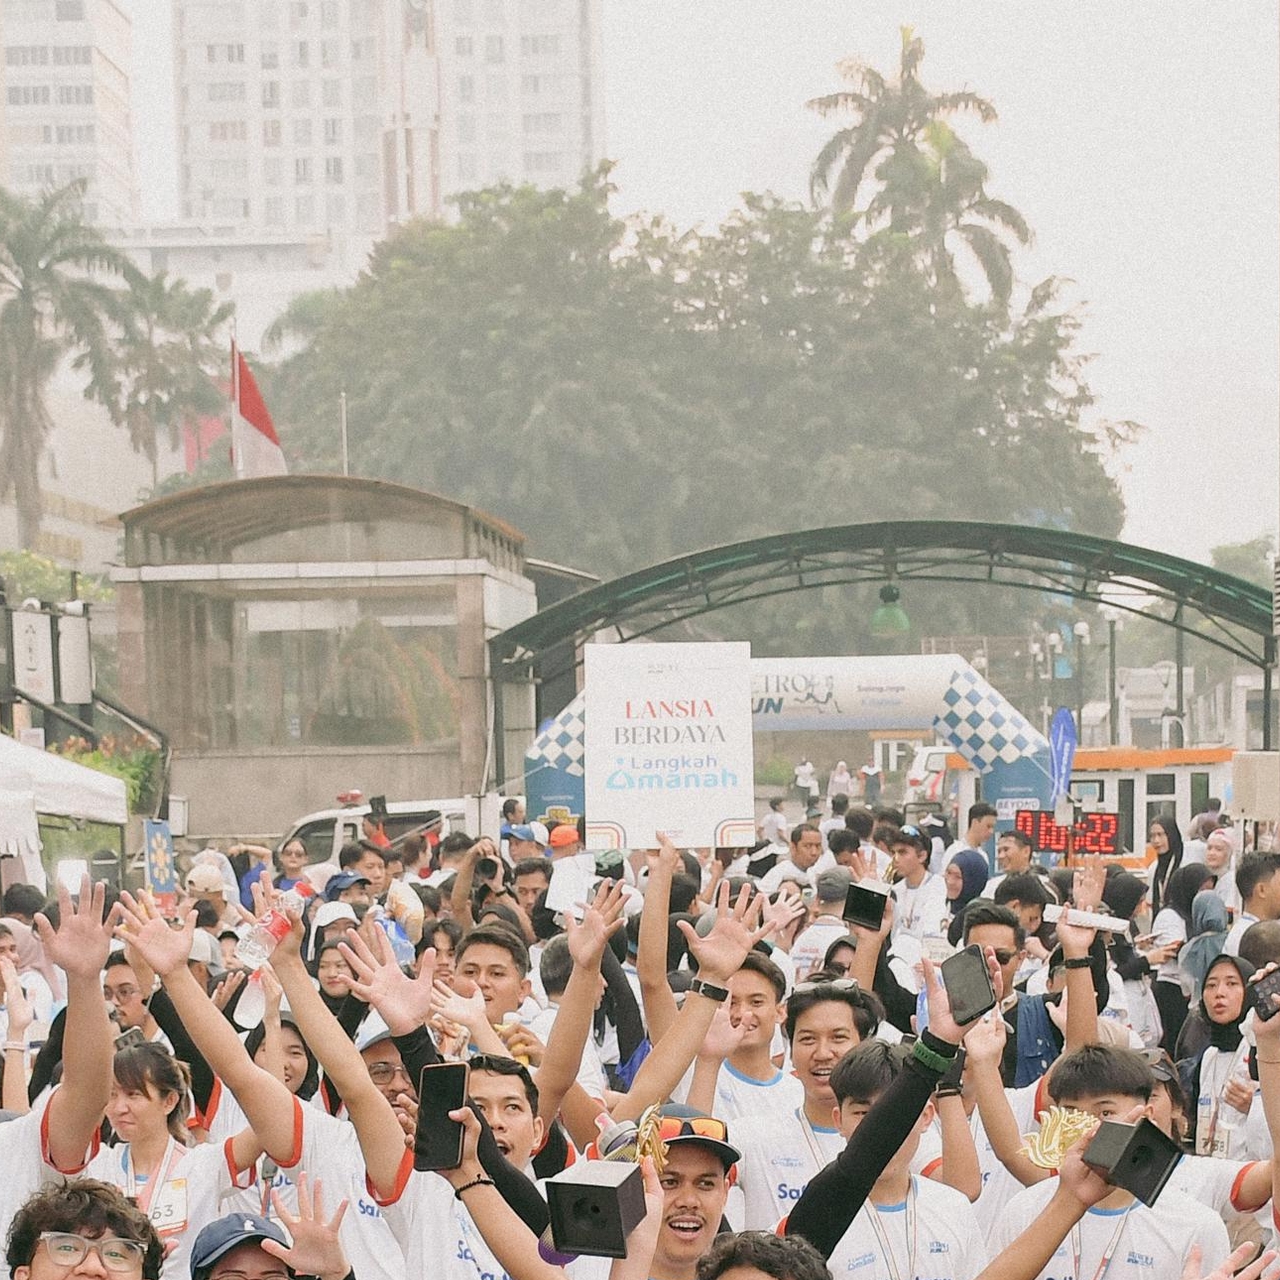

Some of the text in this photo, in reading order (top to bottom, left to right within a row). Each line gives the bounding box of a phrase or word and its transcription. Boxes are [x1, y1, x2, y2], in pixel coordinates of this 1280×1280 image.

[625, 700, 714, 720] LANSIA
[614, 725, 726, 746] BERDAYA
[631, 755, 718, 773] Langkah
